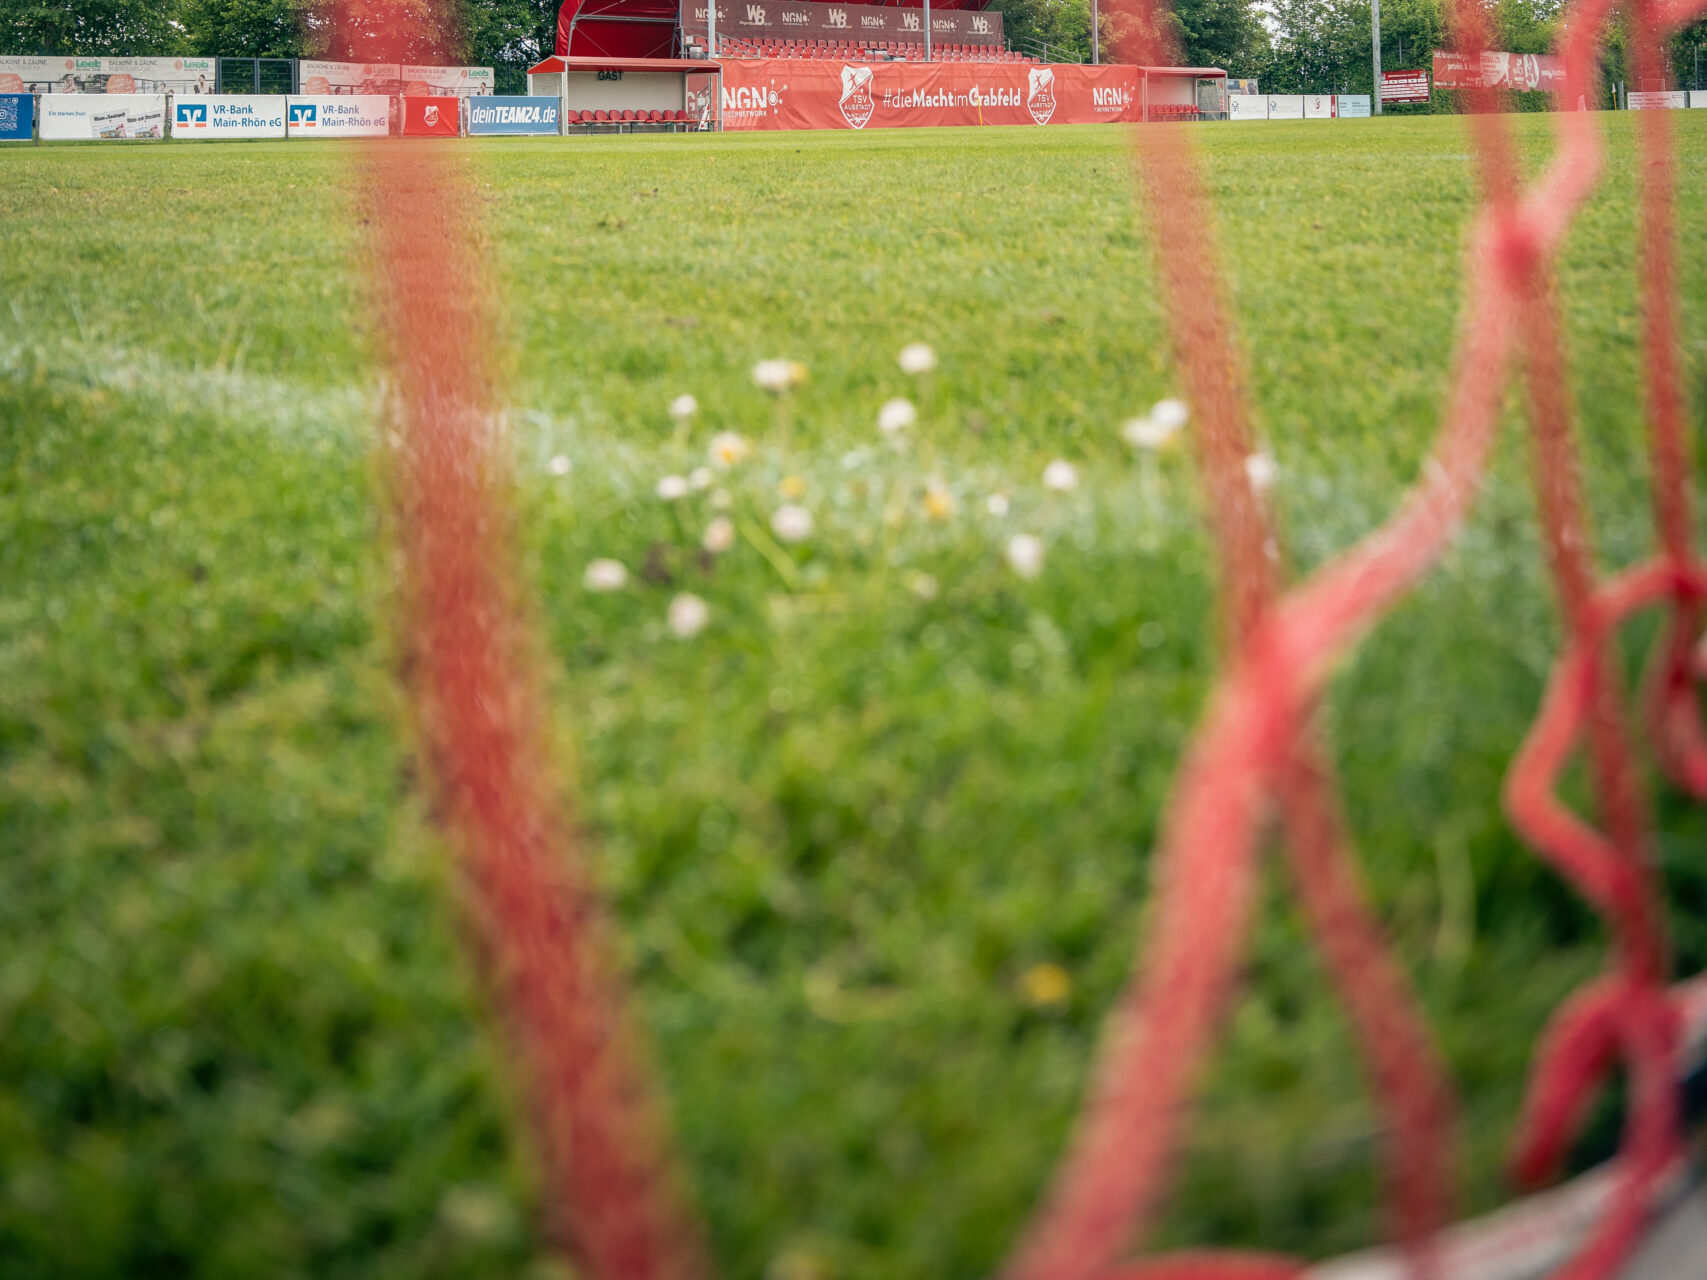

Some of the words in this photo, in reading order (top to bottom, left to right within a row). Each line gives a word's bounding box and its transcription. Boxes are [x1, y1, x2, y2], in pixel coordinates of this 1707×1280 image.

[782, 12, 803, 23] NGN
[861, 15, 880, 26] NGN
[932, 19, 950, 29] NGN
[183, 60, 209, 68] Leeb
[468, 69, 489, 77] Leeb
[598, 71, 624, 81] GAST
[722, 86, 767, 109] NGN
[853, 95, 868, 104] TSV
[1093, 87, 1122, 106] NGN
[213, 104, 253, 115] VR-Bank
[322, 105, 359, 115] VR-Bank
[473, 105, 556, 124] deinTEAM24.de
[213, 117, 267, 128] Main-Rhön
[269, 118, 282, 127] eG
[322, 117, 371, 127] Main-Rhön
[373, 117, 386, 127] eG
